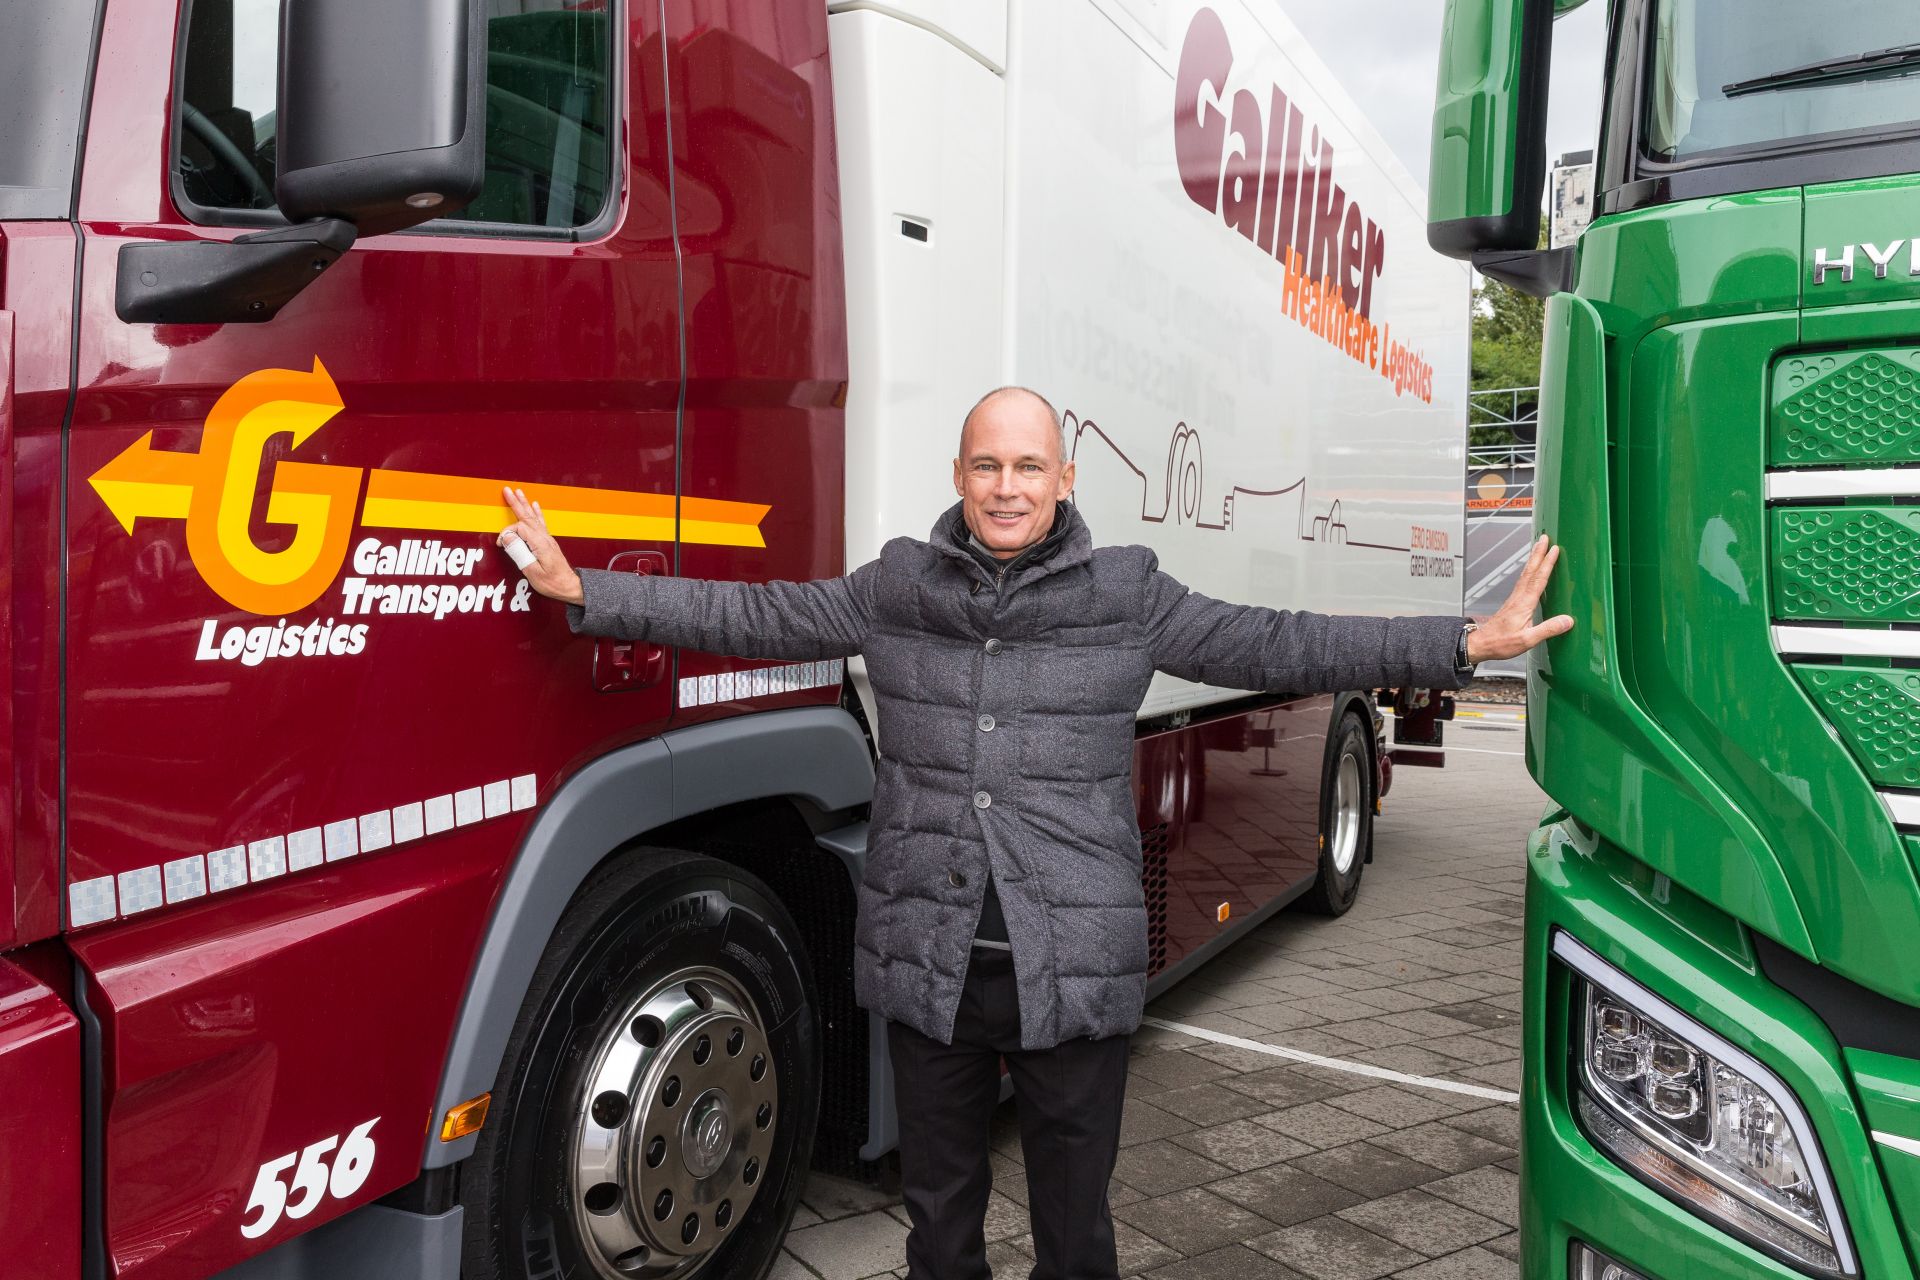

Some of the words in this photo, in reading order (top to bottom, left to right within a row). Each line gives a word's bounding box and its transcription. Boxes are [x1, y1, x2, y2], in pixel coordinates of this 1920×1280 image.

[1174, 6, 1385, 320] Galliker
[1813, 238, 1920, 285] HY
[1281, 244, 1379, 371] Healthcare
[1381, 322, 1433, 405] Logistics
[353, 537, 484, 577] Galliker
[1411, 525, 1424, 549] ZERO
[1411, 554, 1428, 577] GREEN
[342, 576, 507, 620] Transport
[510, 578, 532, 612] &
[195, 617, 370, 667] Logistics
[240, 1115, 382, 1239] 556
